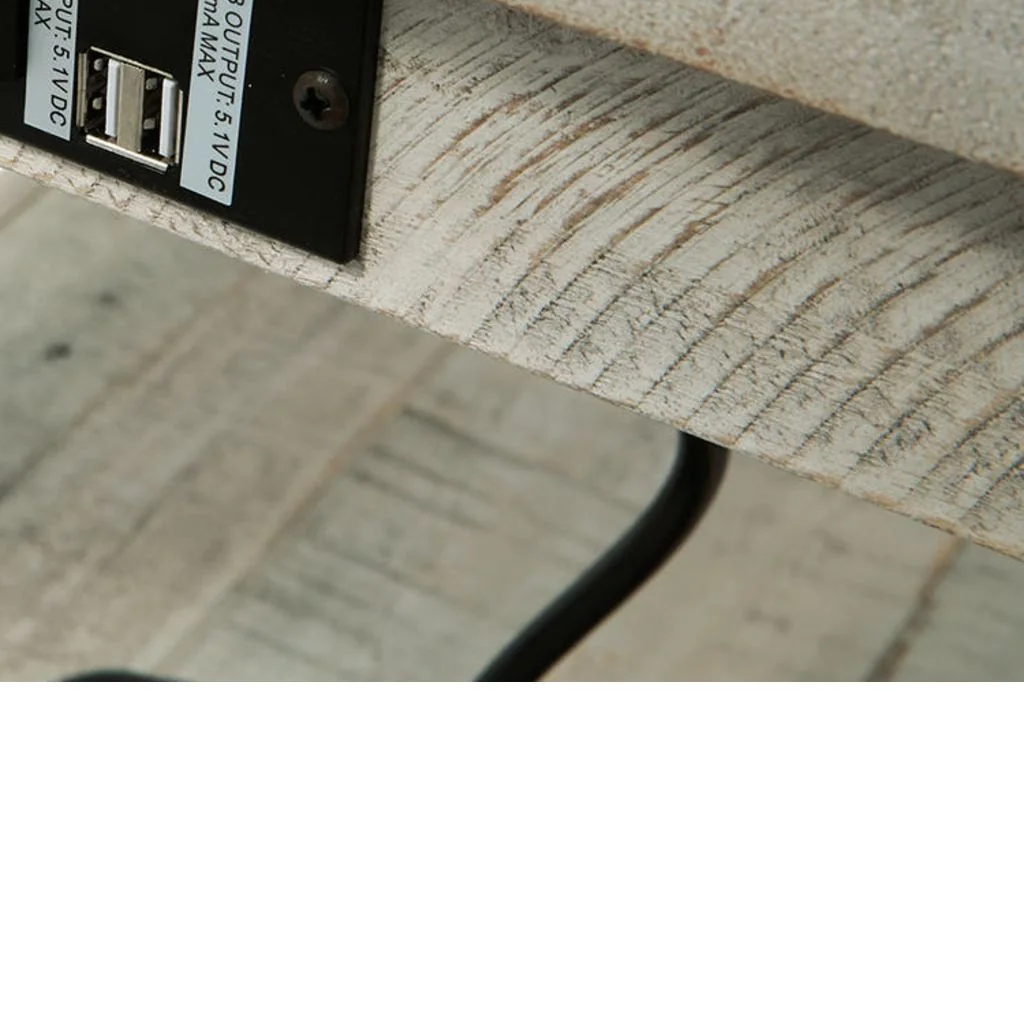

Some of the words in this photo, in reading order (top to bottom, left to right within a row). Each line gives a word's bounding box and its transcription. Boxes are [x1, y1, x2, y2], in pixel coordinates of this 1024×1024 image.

[196, 31, 219, 83] MAX
[216, 10, 243, 107] OUTPUT:
[49, 95, 68, 127] DC
[207, 160, 228, 193] DC
